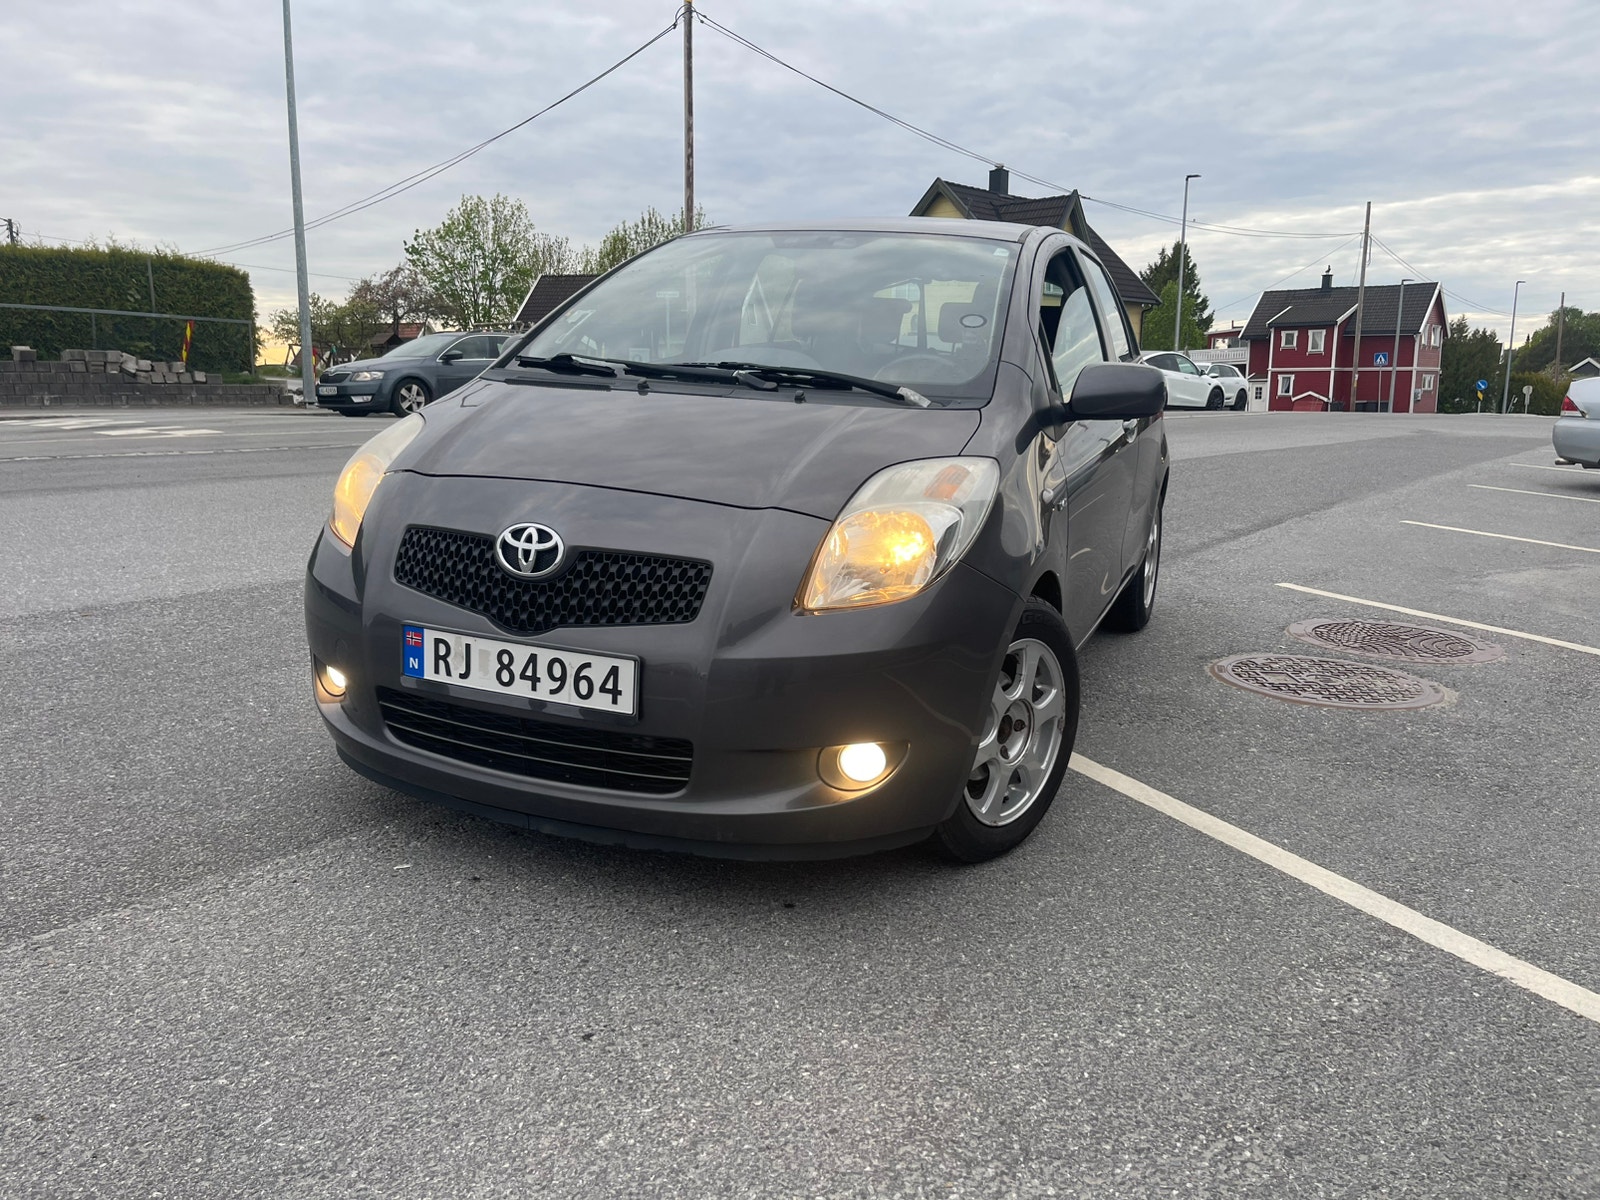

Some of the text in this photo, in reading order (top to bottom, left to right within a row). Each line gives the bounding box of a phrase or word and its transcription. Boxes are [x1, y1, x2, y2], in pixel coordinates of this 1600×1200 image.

[409, 657, 419, 670] N
[433, 637, 623, 706] RJ 84964
